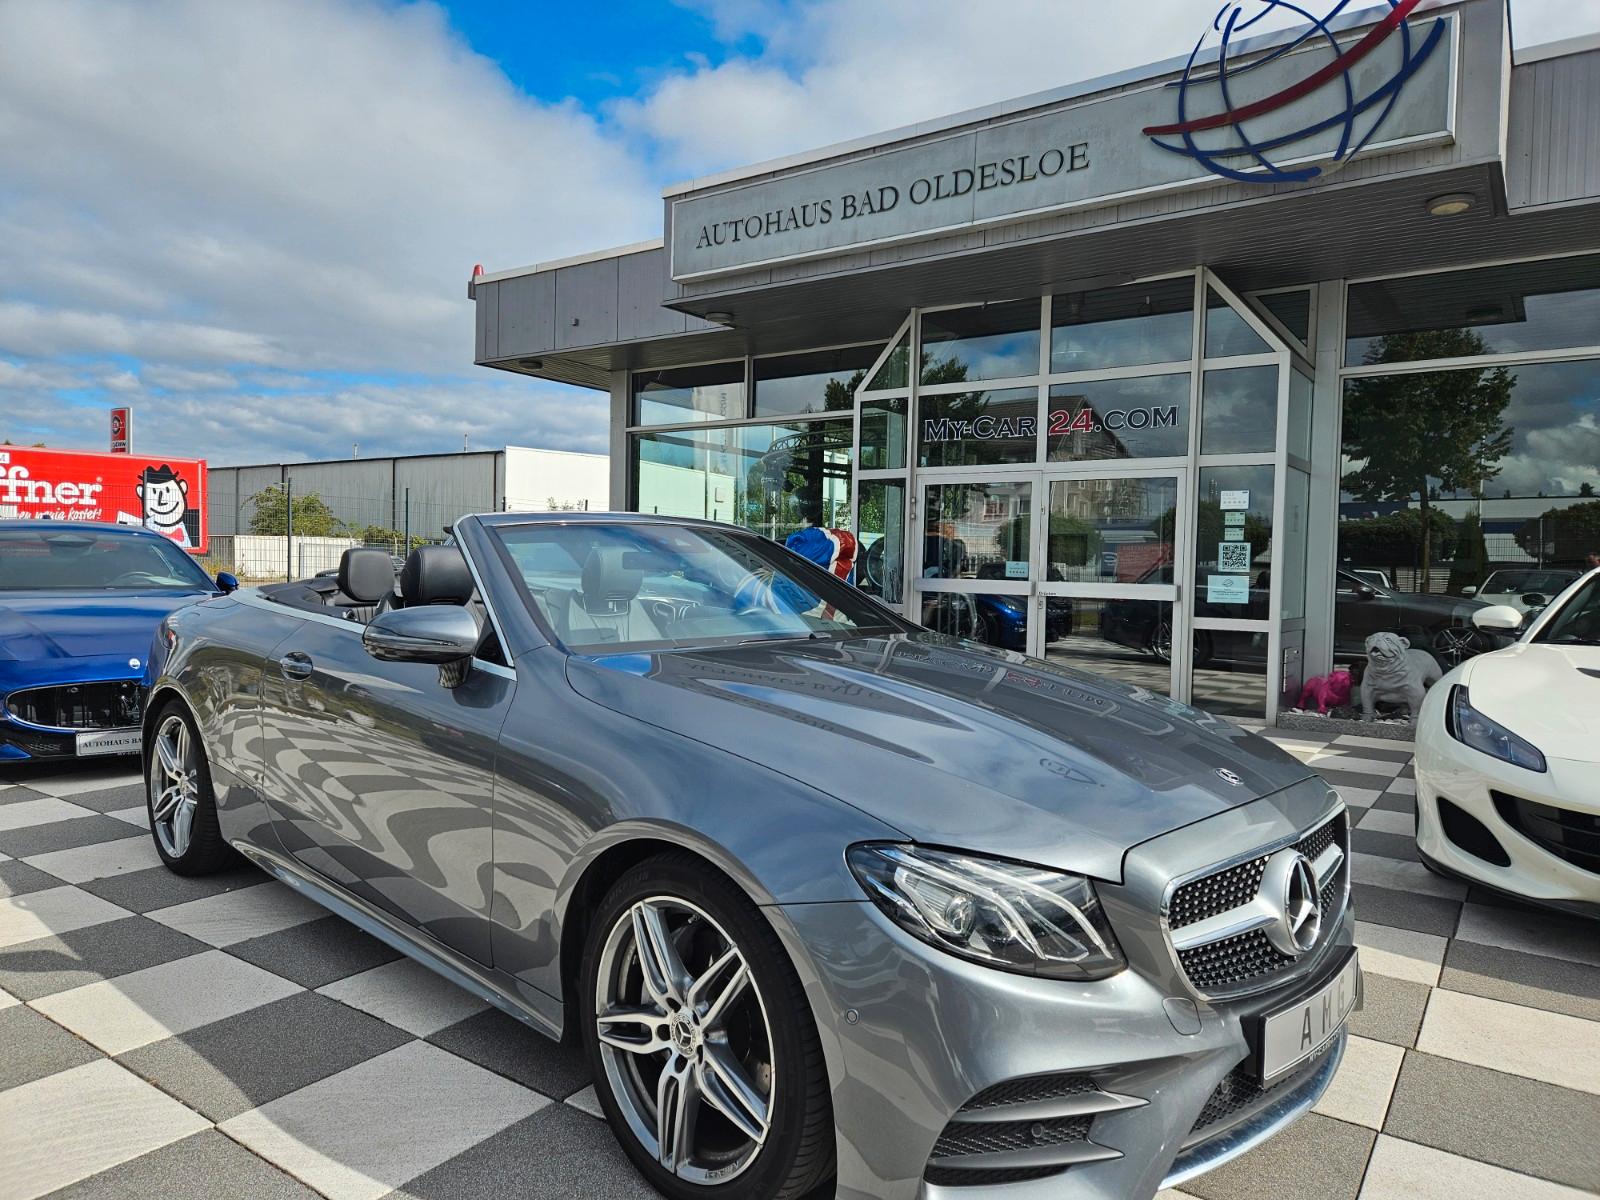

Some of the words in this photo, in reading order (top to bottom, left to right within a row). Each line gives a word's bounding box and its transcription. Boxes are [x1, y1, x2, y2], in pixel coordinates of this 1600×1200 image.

[695, 198, 833, 250] AUTOHAUS
[840, 185, 900, 220] BAD
[909, 142, 1091, 206] OLDESLOE
[0, 466, 102, 505] fner
[67, 507, 103, 520] kostet!
[83, 738, 130, 748] AUTOHAUS
